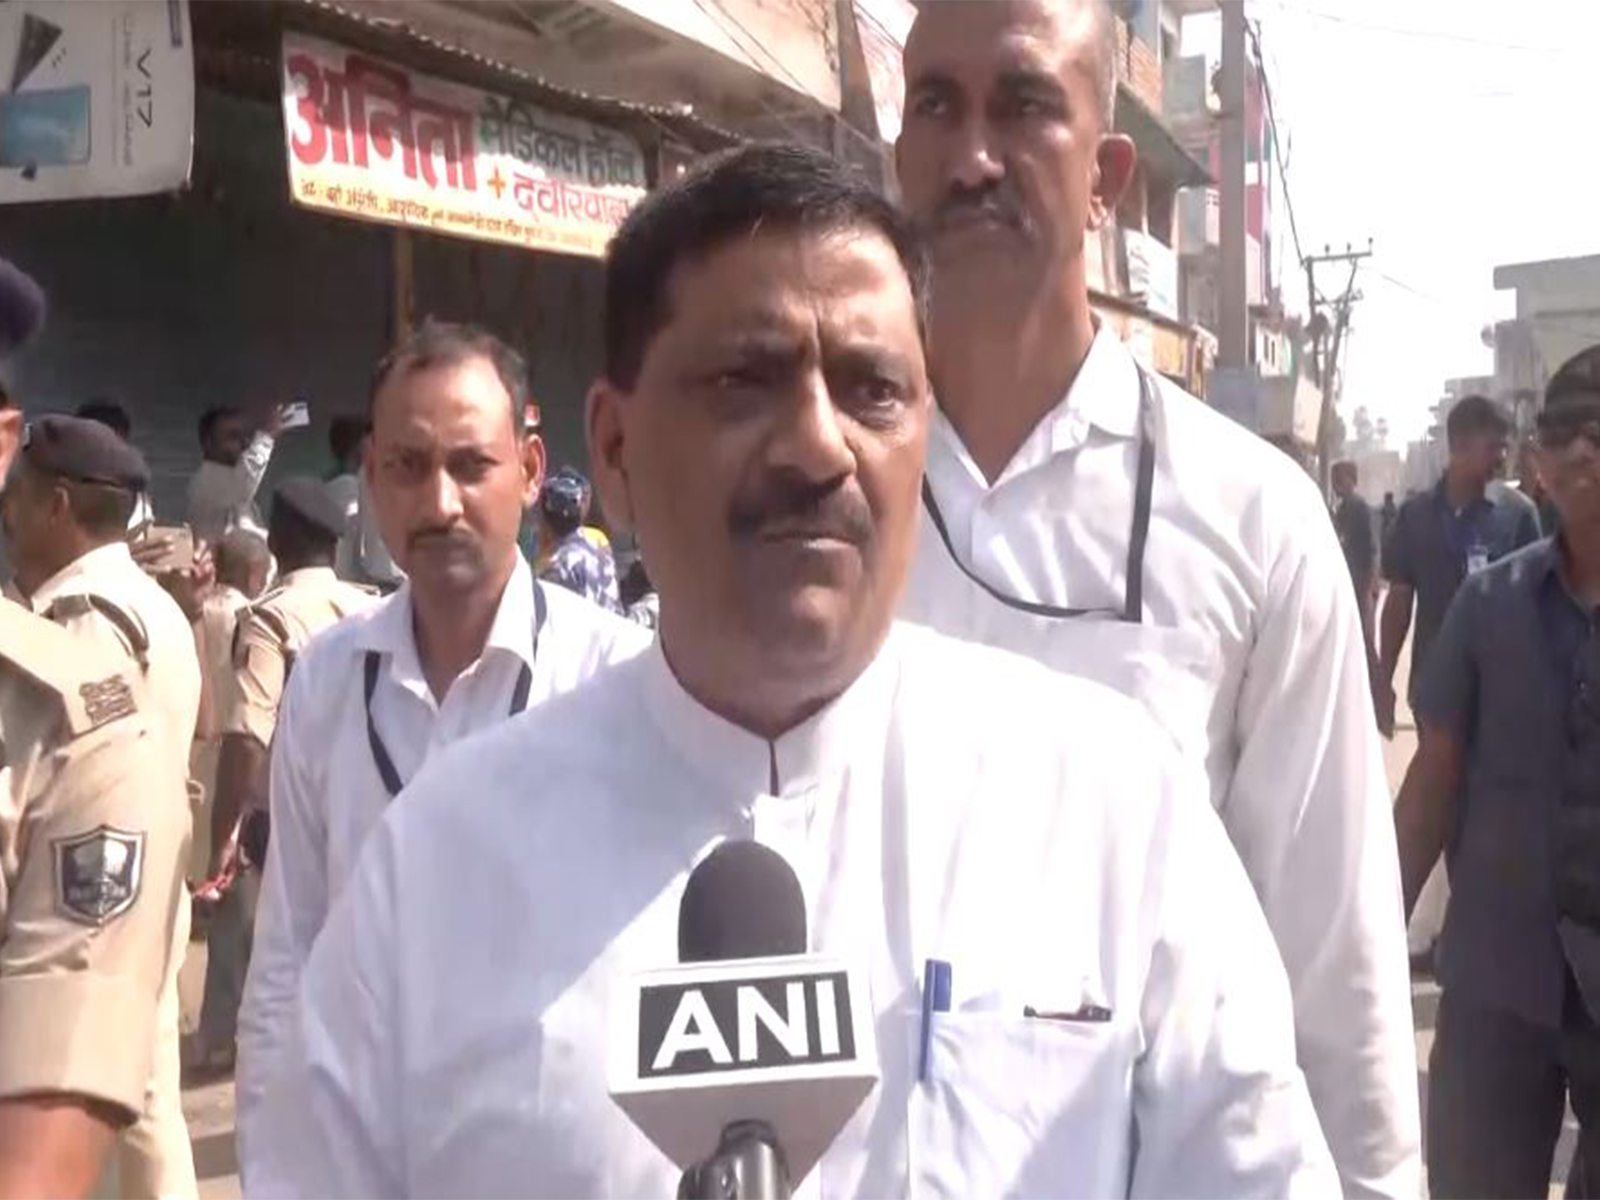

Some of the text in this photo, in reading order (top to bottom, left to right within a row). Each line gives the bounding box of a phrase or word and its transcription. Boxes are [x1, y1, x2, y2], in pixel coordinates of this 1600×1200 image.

[137, 48, 153, 128] V17
[287, 53, 477, 191] अनिता
[651, 980, 841, 1070] ANI
